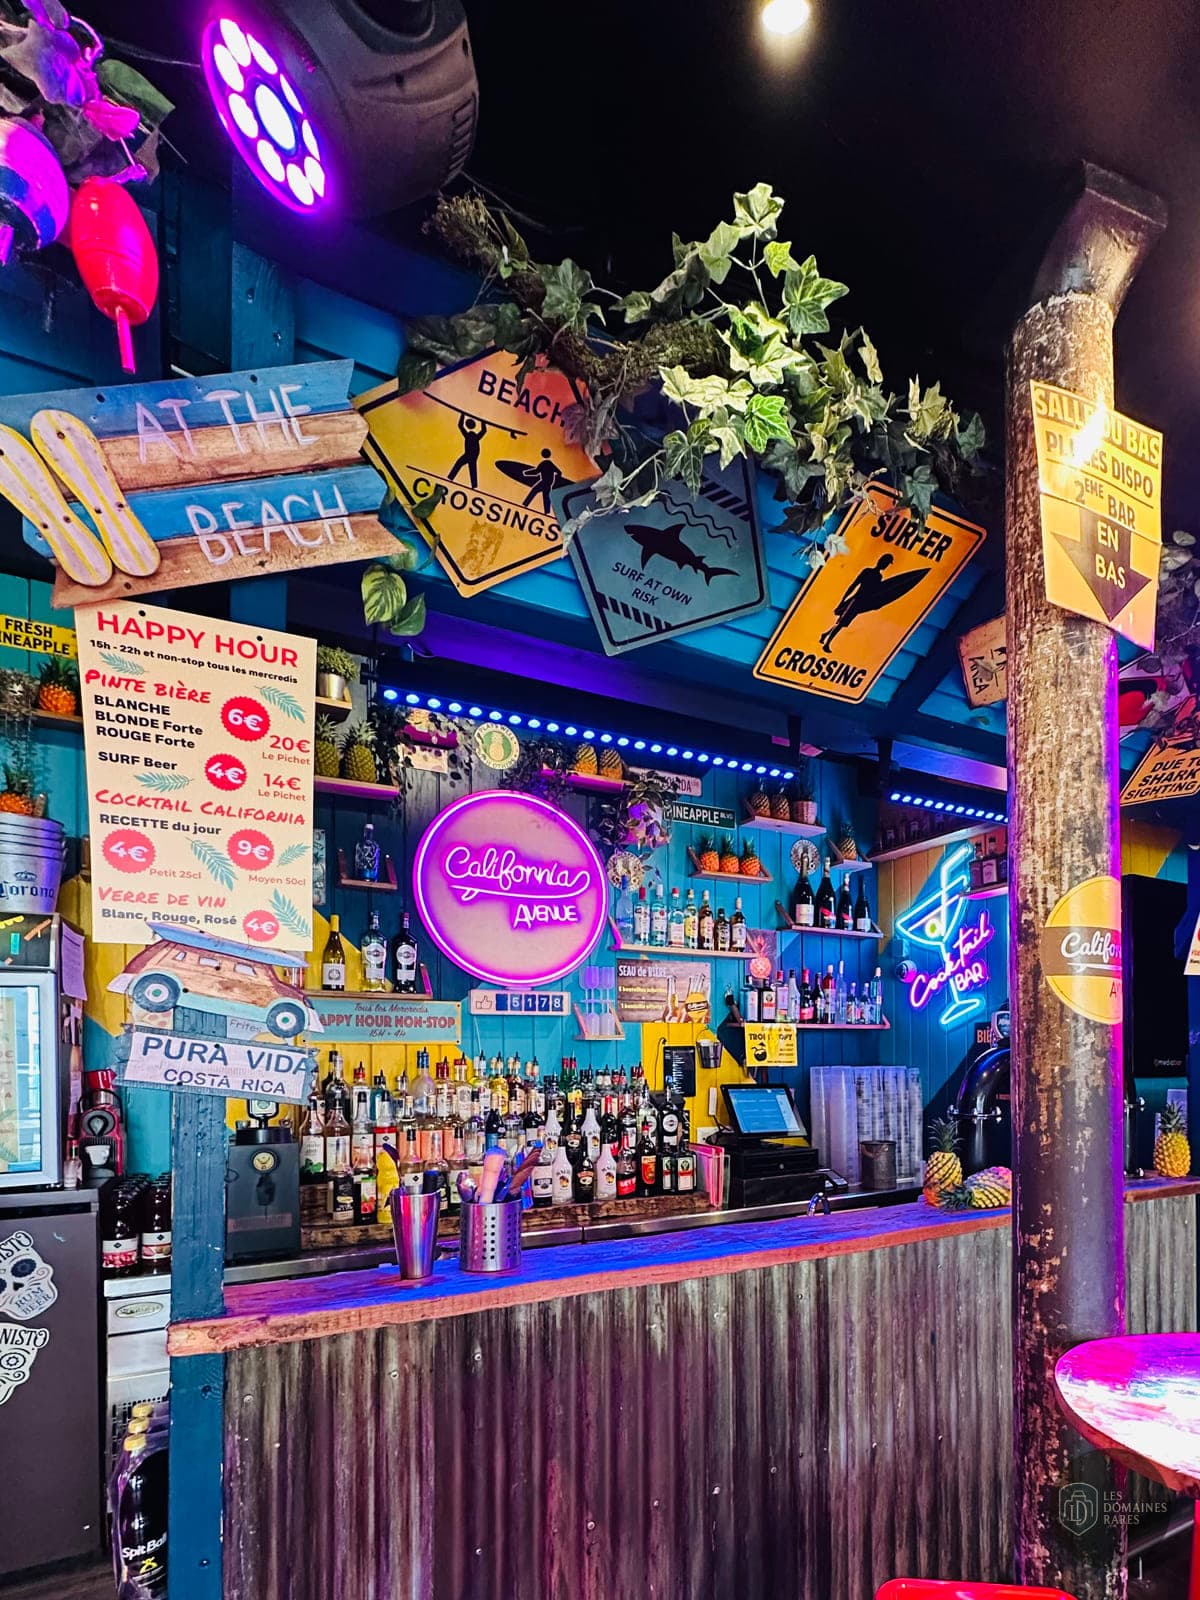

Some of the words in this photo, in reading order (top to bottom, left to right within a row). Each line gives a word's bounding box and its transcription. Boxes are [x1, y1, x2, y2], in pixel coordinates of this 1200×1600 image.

[478, 369, 566, 427] BEACH
[136, 398, 198, 464] AT
[203, 383, 319, 455] THE
[1126, 425, 1160, 467] BAS
[1111, 456, 1153, 499] DISPO
[412, 477, 561, 542] CROSSINGS
[1107, 494, 1136, 529] BAR
[186, 484, 356, 566] BEACH
[1097, 520, 1119, 553] EN
[870, 512, 953, 563] SURFER
[612, 561, 644, 582] SURF
[643, 577, 662, 592] AT
[662, 585, 693, 605] OWN
[1095, 553, 1126, 590] BAS
[631, 589, 660, 606] RISK
[5, 618, 53, 639] FRESH
[97, 611, 206, 650] HAPPY
[215, 634, 299, 668] HOUR
[90, 639, 111, 651] 15h
[119, 644, 141, 656] 22h
[143, 650, 155, 659] et
[157, 653, 205, 667] non-stop
[206, 660, 230, 672] tous
[232, 664, 247, 676] les
[248, 668, 298, 684] mercredis
[774, 647, 867, 689] CROSSING
[84, 668, 146, 693] PINTE
[154, 680, 212, 705] BIÈRE
[94, 694, 170, 716] BLANCHE
[95, 710, 159, 731] BLONDE
[162, 720, 204, 736] Forte
[227, 708, 263, 732] 6€
[96, 725, 151, 743] ROUGE
[155, 734, 196, 749] Forte
[269, 734, 310, 754] 20€
[98, 751, 140, 767] SURF
[144, 757, 178, 771] Beer
[261, 752, 274, 761] Le
[277, 753, 310, 766] Pichet
[1150, 757, 1183, 773] DUE
[207, 761, 245, 785] 4€
[263, 773, 301, 791] 14€
[1138, 767, 1200, 787] SHARK
[257, 788, 270, 798] Le
[273, 790, 306, 802] Pichet
[1125, 781, 1200, 800] SIGHTING
[95, 789, 193, 813] COCKTAIL
[200, 800, 305, 825] CALIFORNIA
[100, 814, 169, 830] RECETTE
[172, 823, 190, 834] du
[191, 823, 222, 836] jour
[109, 841, 149, 862] 4€
[237, 840, 270, 861] 9€
[149, 867, 176, 879] Petit
[178, 868, 202, 880] 25cl
[248, 874, 283, 887] Moyen
[285, 875, 306, 887] 50cl
[446, 847, 591, 894] California
[98, 886, 160, 905] VERRE
[167, 893, 189, 906] DE
[198, 894, 226, 909] VIN
[101, 908, 149, 922] Blanc,
[151, 911, 201, 926] Rouge,
[204, 913, 237, 926] Rosé
[246, 918, 275, 935] 4€
[513, 904, 579, 929] AVENUE
[955, 962, 984, 992] BAR
[511, 995, 564, 1009] 5178
[355, 1015, 392, 1028] HOUR
[395, 1015, 456, 1029] NON-STOP
[142, 1036, 228, 1067] PURA
[247, 1050, 308, 1075] VIDA
[163, 1068, 231, 1089] COSTA
[241, 1078, 286, 1095] RICA
[14, 1286, 45, 1308] RUM
[22, 1294, 52, 1315] BEER
[122, 1546, 147, 1561] Spit
